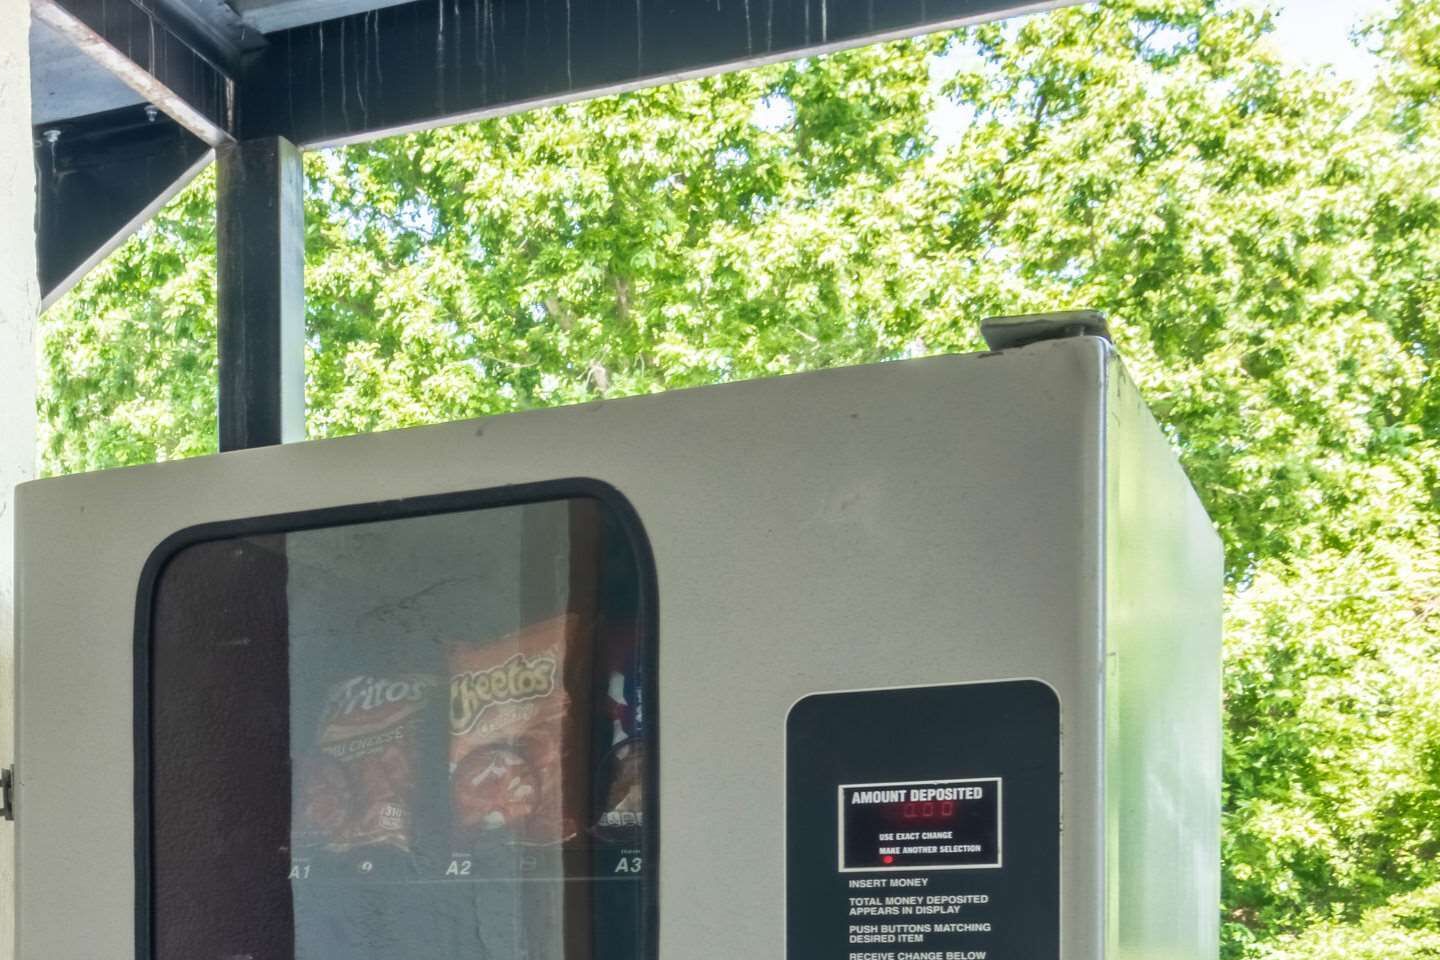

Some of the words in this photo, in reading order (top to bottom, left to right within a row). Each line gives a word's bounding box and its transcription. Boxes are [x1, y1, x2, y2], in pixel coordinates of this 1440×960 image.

[451, 656, 553, 732] Cheetos
[852, 790, 906, 804] AMOUNT
[910, 787, 982, 801] DEPOSITED
[896, 832, 919, 840] EXACT
[922, 831, 952, 839] CHANGE
[902, 846, 937, 854] ANOTHER
[940, 845, 981, 853] SELECTION
[446, 860, 472, 875] A2
[615, 857, 643, 873] A3
[288, 864, 311, 879] A1
[849, 879, 886, 888] INSERT
[890, 878, 928, 887] MONEY
[849, 897, 883, 906] TOTAL
[885, 896, 923, 905] MONEY
[926, 895, 988, 904] DEPOSITED
[849, 907, 899, 915] APPEARS
[902, 906, 912, 914] IN
[915, 905, 960, 914] DISPLAY
[849, 925, 878, 934] PUSH
[881, 924, 931, 933] BUTTONS
[934, 923, 991, 932] MATCHING
[849, 934, 896, 943] DESIRED
[898, 934, 923, 942] ITEM
[849, 953, 895, 960] RECEIVE
[897, 952, 943, 960] CHANGE
[946, 952, 986, 960] BELOW
